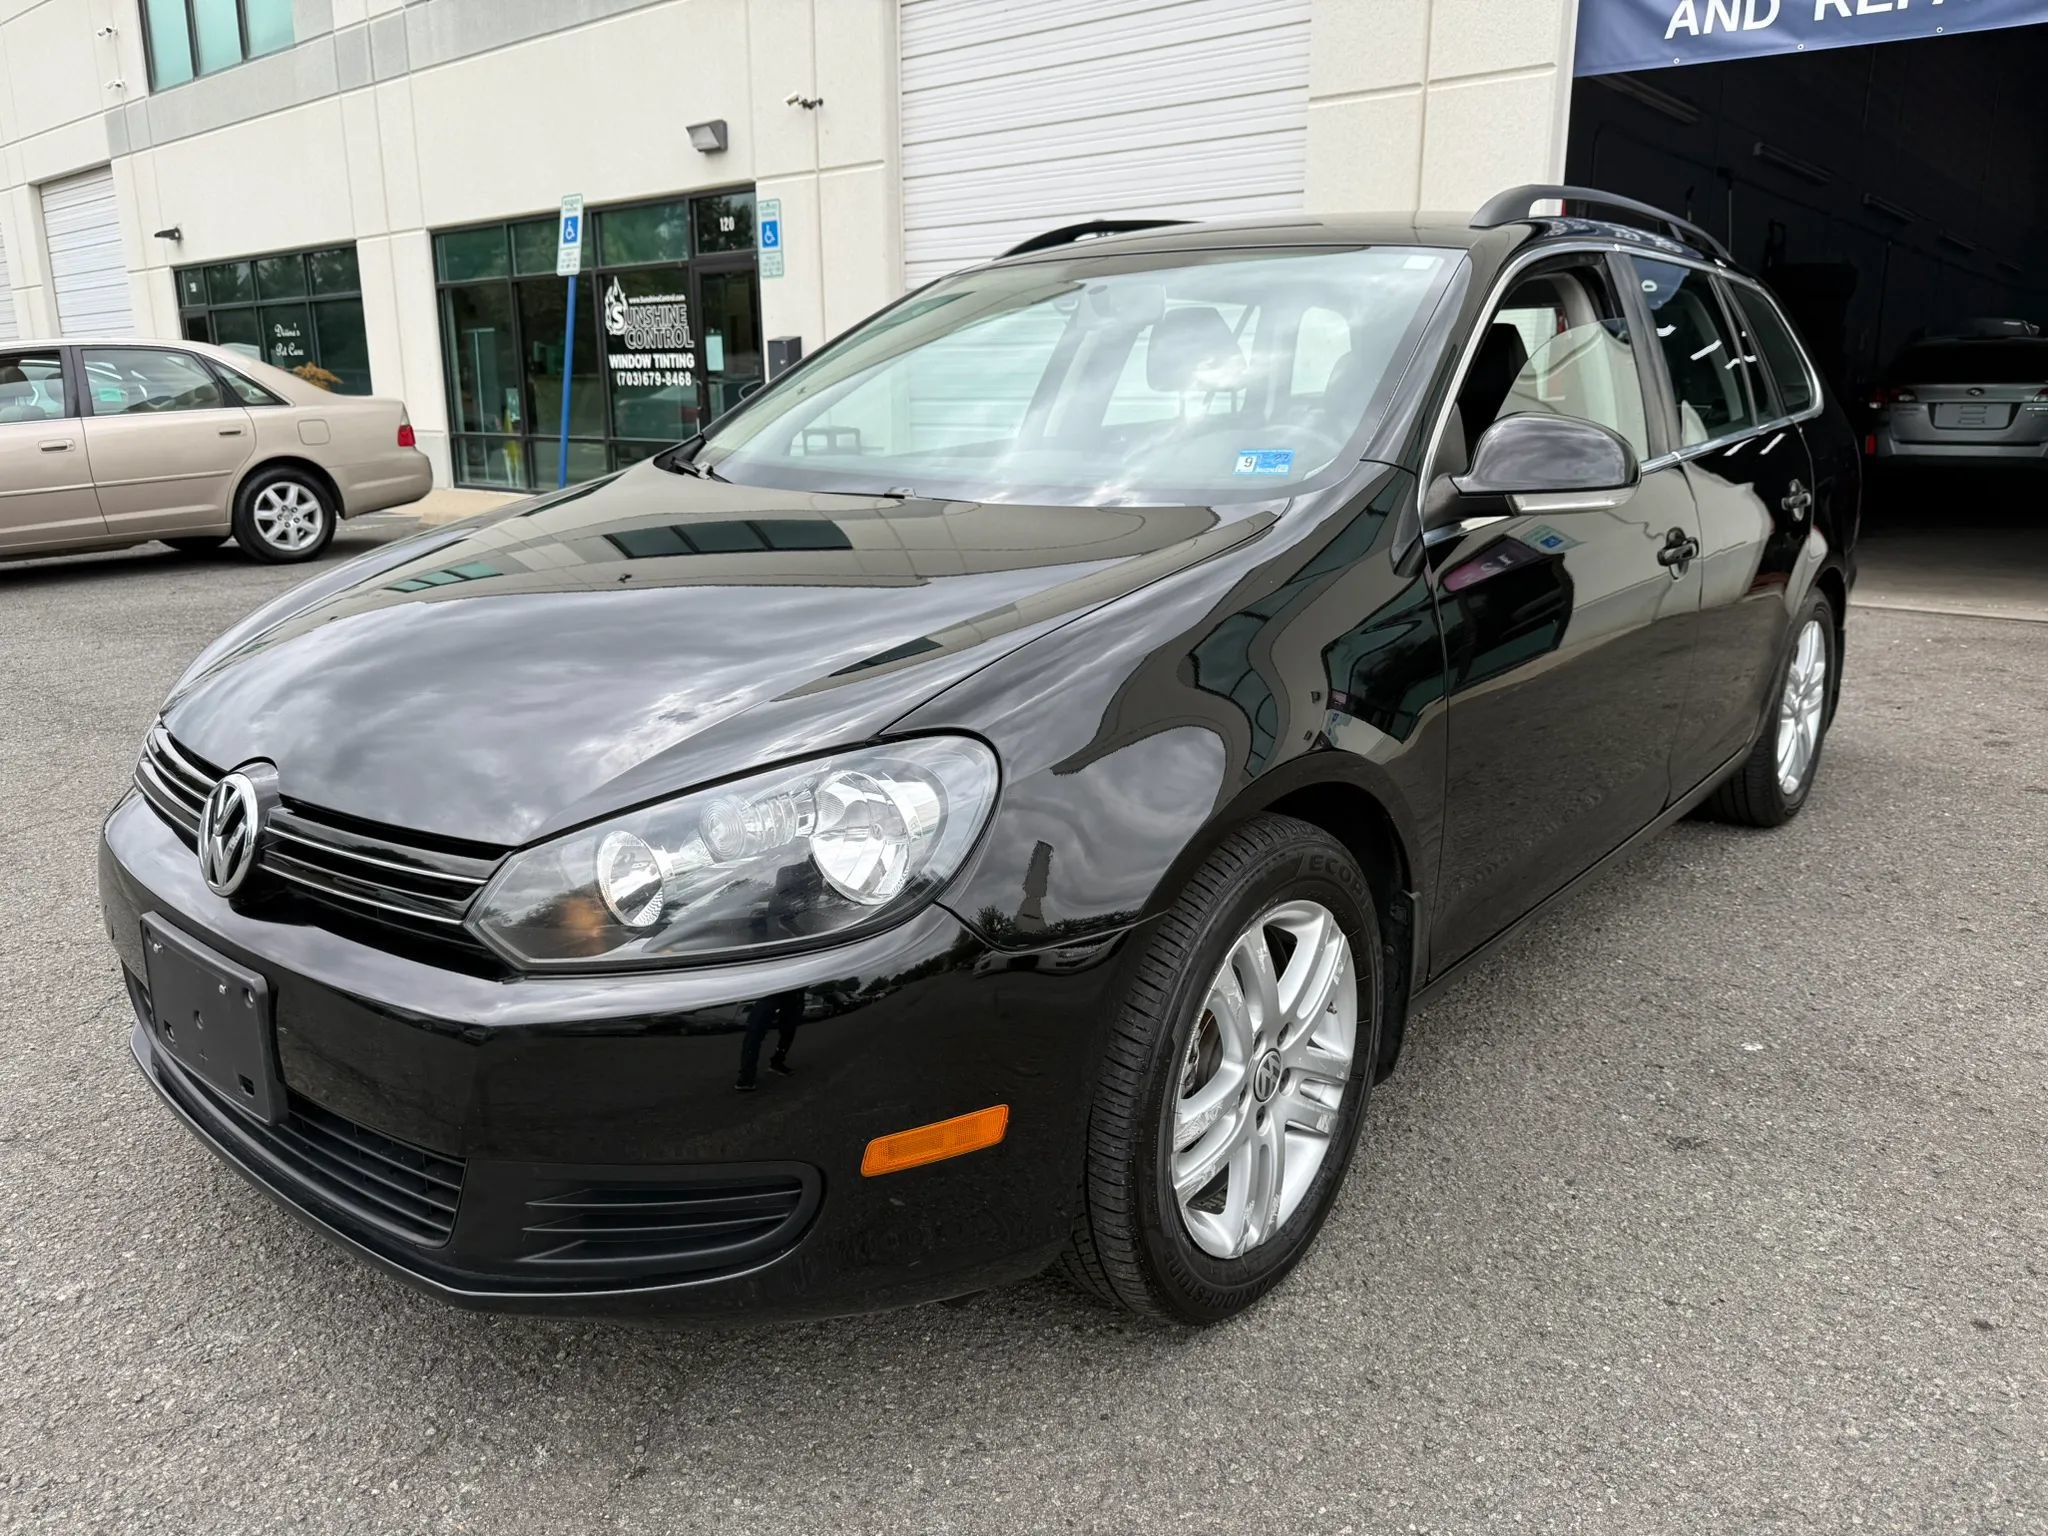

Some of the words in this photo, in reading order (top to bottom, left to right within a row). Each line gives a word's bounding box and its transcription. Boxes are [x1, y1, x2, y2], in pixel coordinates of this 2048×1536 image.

[1664, 0, 1780, 40] AND
[720, 216, 735, 232] 120
[610, 302, 687, 331] SUNSHINE
[624, 326, 695, 349] CONTROL
[608, 354, 651, 369] WINDOW
[652, 353, 695, 369] TINTING
[616, 371, 692, 386] (703)679-8468
[1244, 456, 1253, 467] 9
